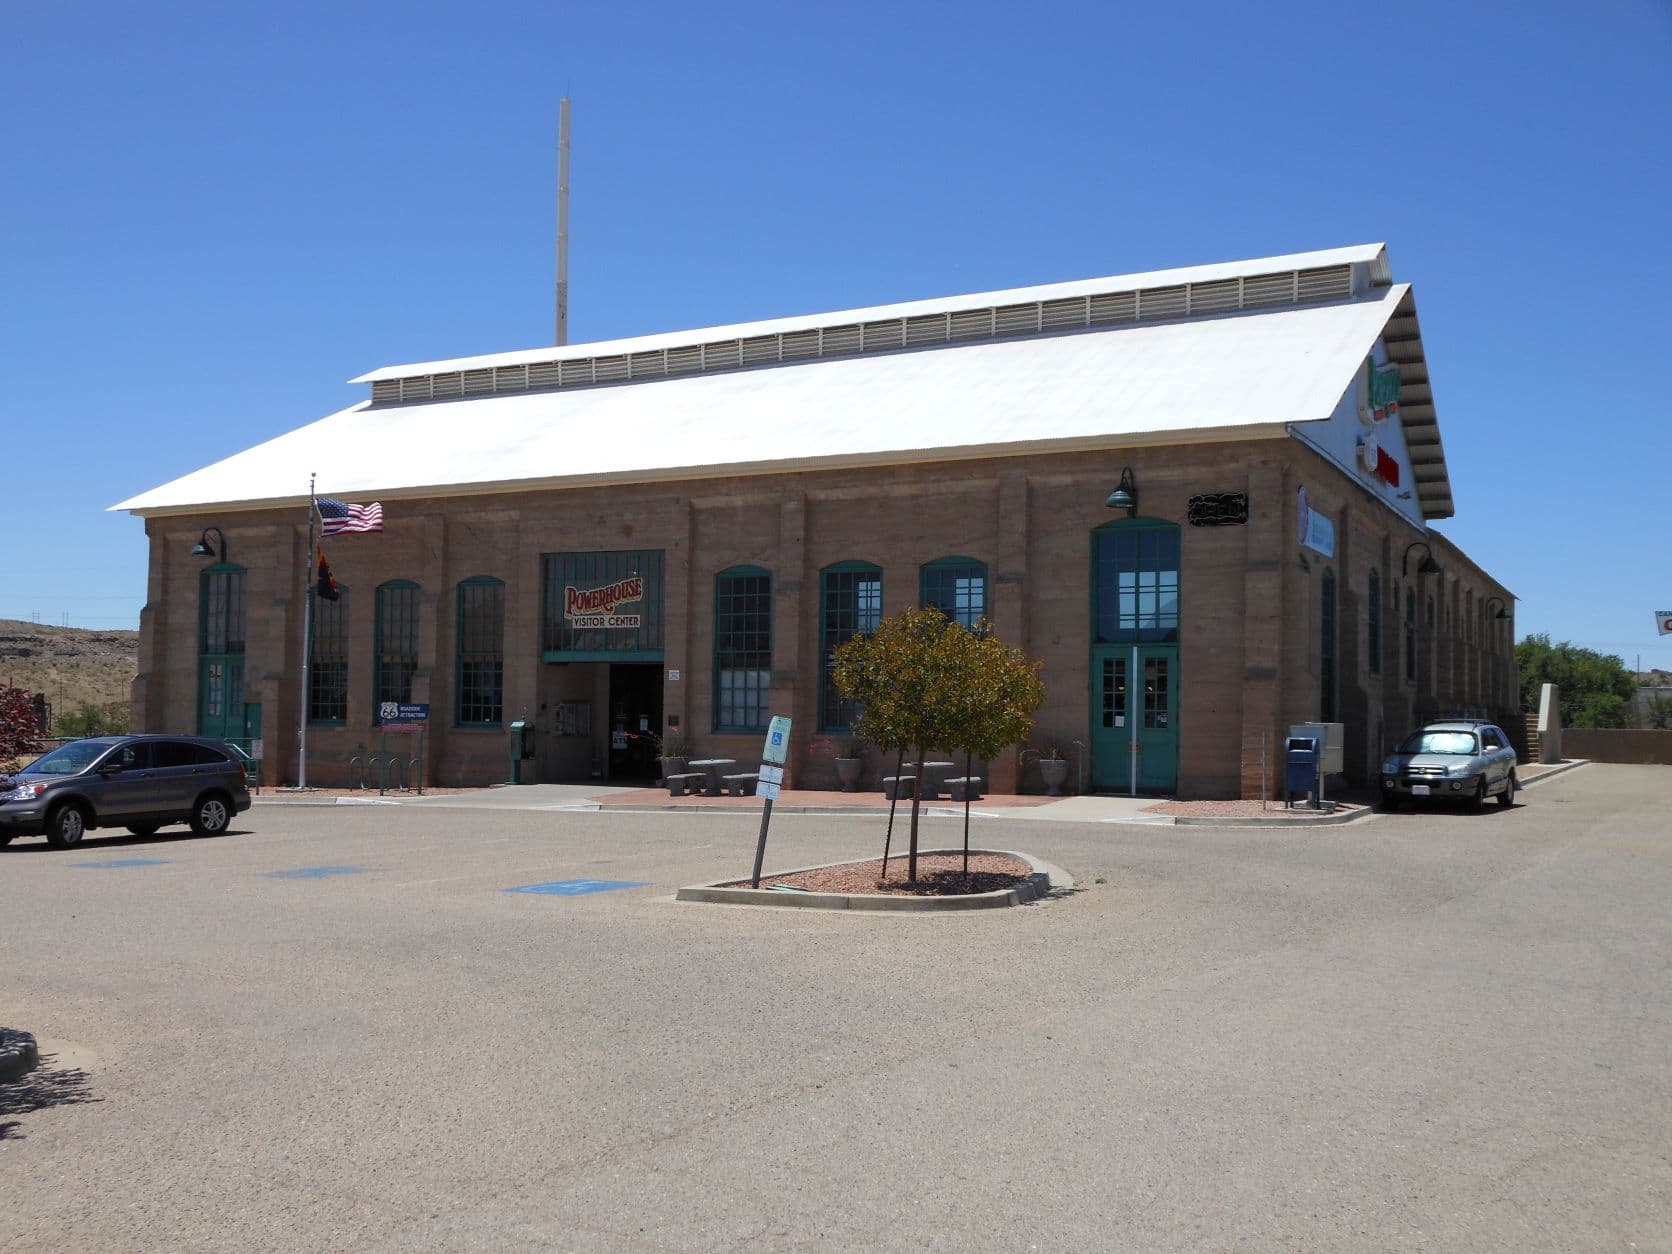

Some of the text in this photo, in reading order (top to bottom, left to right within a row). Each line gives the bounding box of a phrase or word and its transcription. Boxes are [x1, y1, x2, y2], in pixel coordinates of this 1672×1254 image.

[566, 579, 642, 615] POWERHOUSE
[574, 616, 639, 627] VISITOR CENTER
[382, 706, 397, 718] 66
